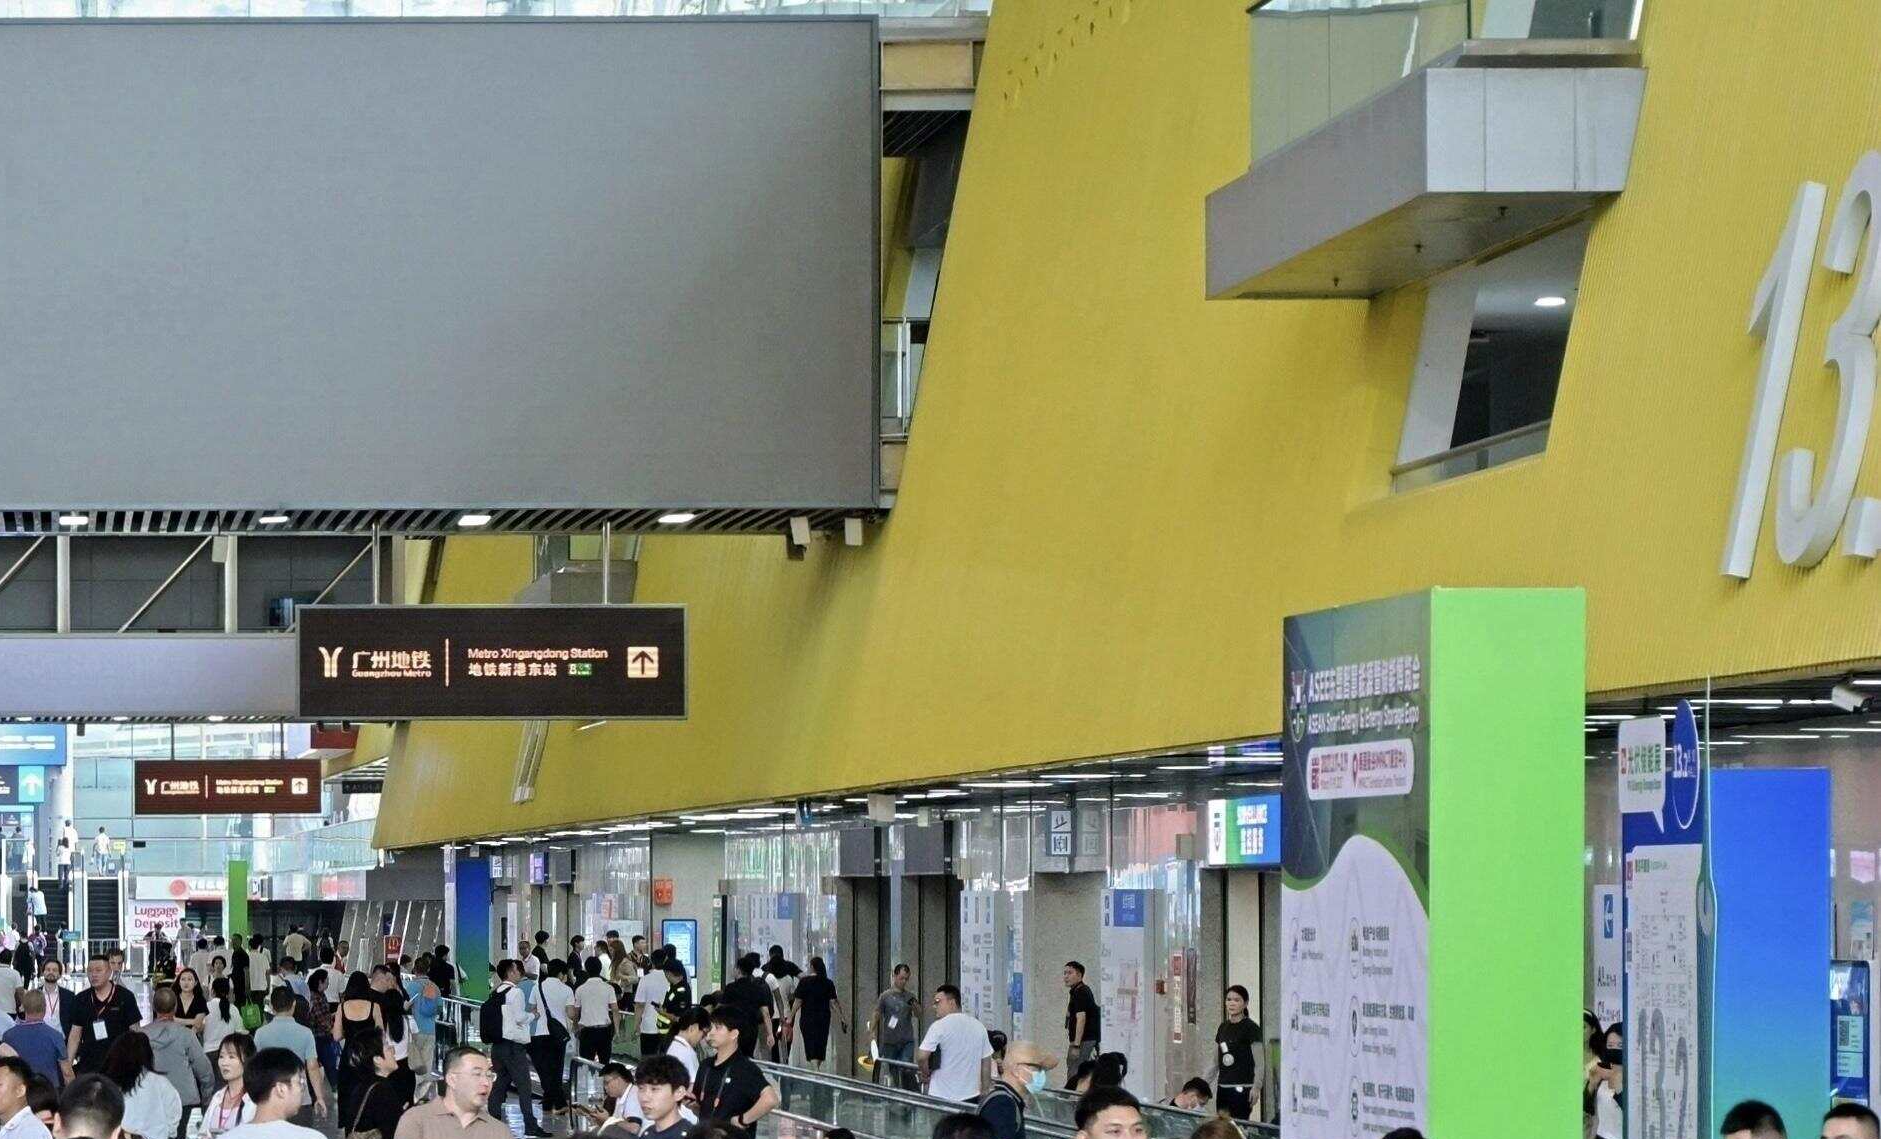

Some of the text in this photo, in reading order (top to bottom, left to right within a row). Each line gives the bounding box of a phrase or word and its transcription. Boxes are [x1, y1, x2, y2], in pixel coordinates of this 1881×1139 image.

[352, 651, 431, 669] 广州地铁
[468, 648, 608, 660] Metro Xingangdong Station
[352, 669, 432, 678] Guangzhou Metro
[468, 663, 557, 676] 地铁新港东站
[134, 905, 179, 919] Luggage
[134, 918, 179, 930] Deposit
